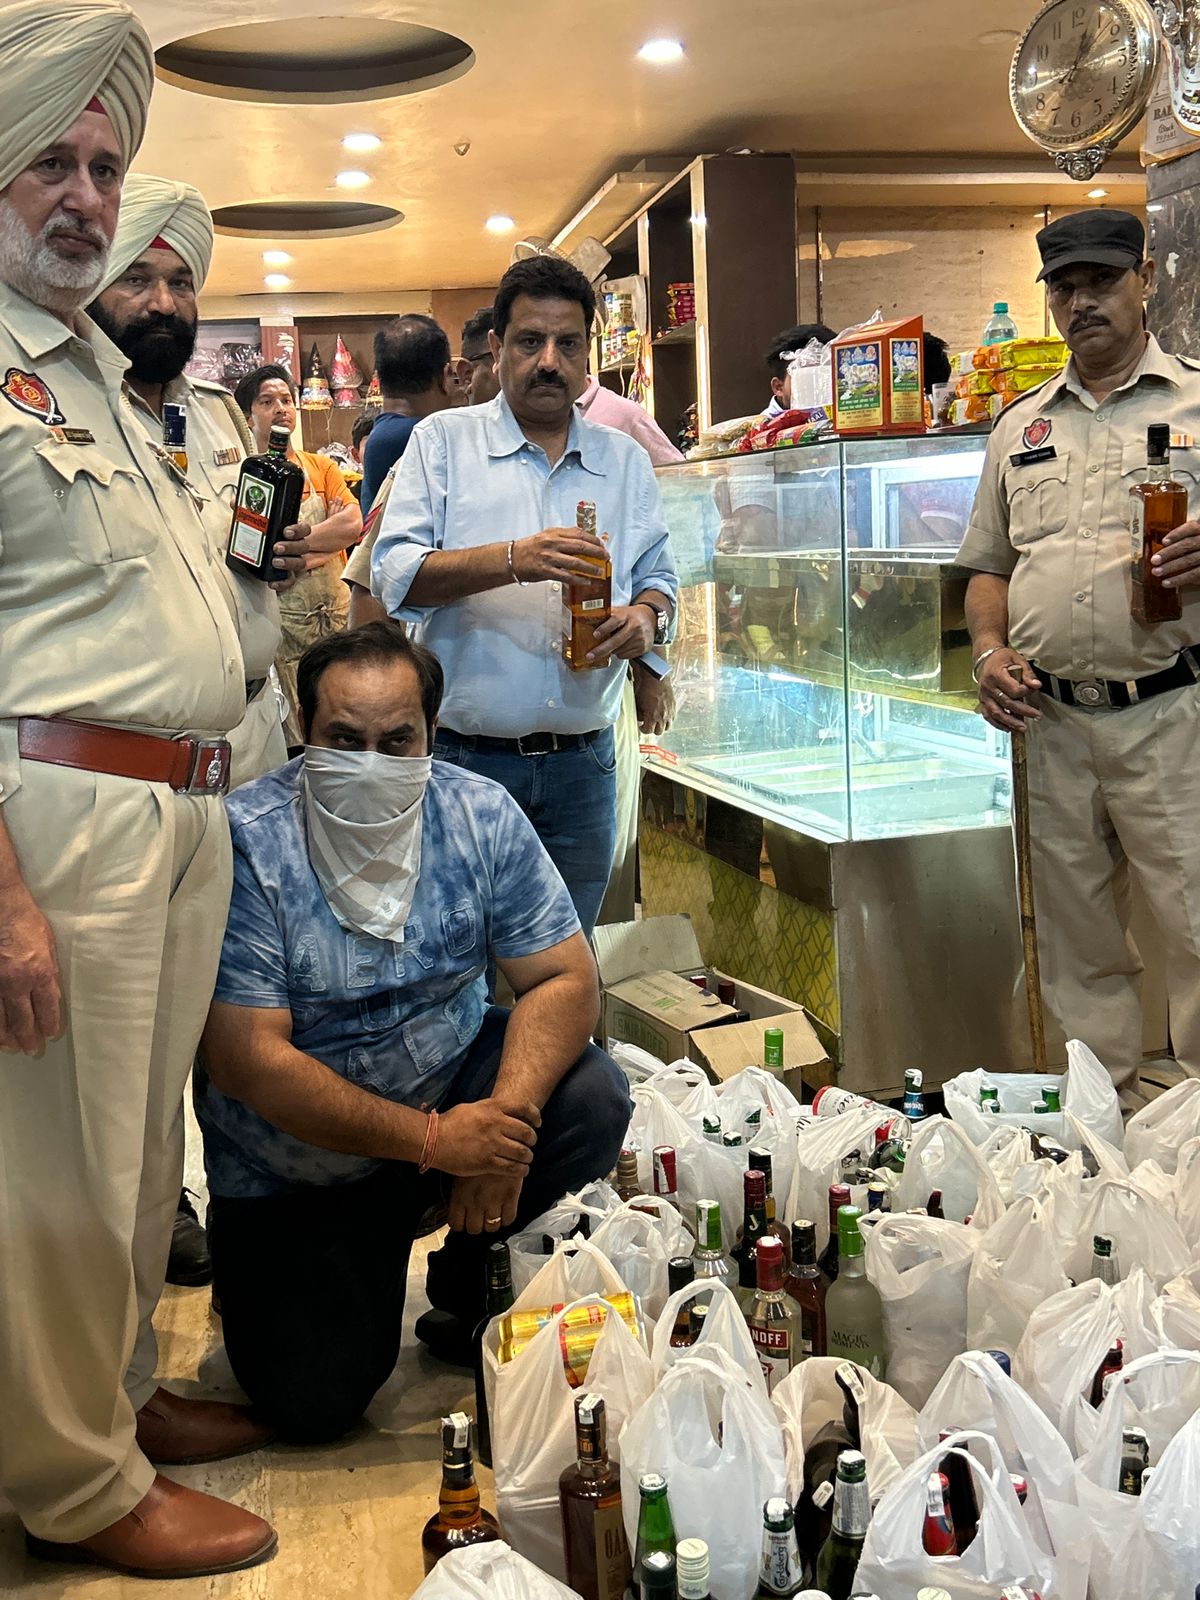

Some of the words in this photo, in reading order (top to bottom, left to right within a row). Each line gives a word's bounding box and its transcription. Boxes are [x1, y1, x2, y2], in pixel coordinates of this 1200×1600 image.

[1072, 7, 1085, 29] 12
[1053, 21, 1061, 40] 11
[1036, 43, 1049, 62] 10
[1106, 76, 1117, 95] 4
[1036, 92, 1046, 111] 8
[1051, 106, 1060, 126] 7
[1071, 110, 1081, 128] 6
[290, 898, 477, 992] AERO
[832, 1330, 867, 1343] MAGIC
[773, 1546, 790, 1589] Carlsberg
